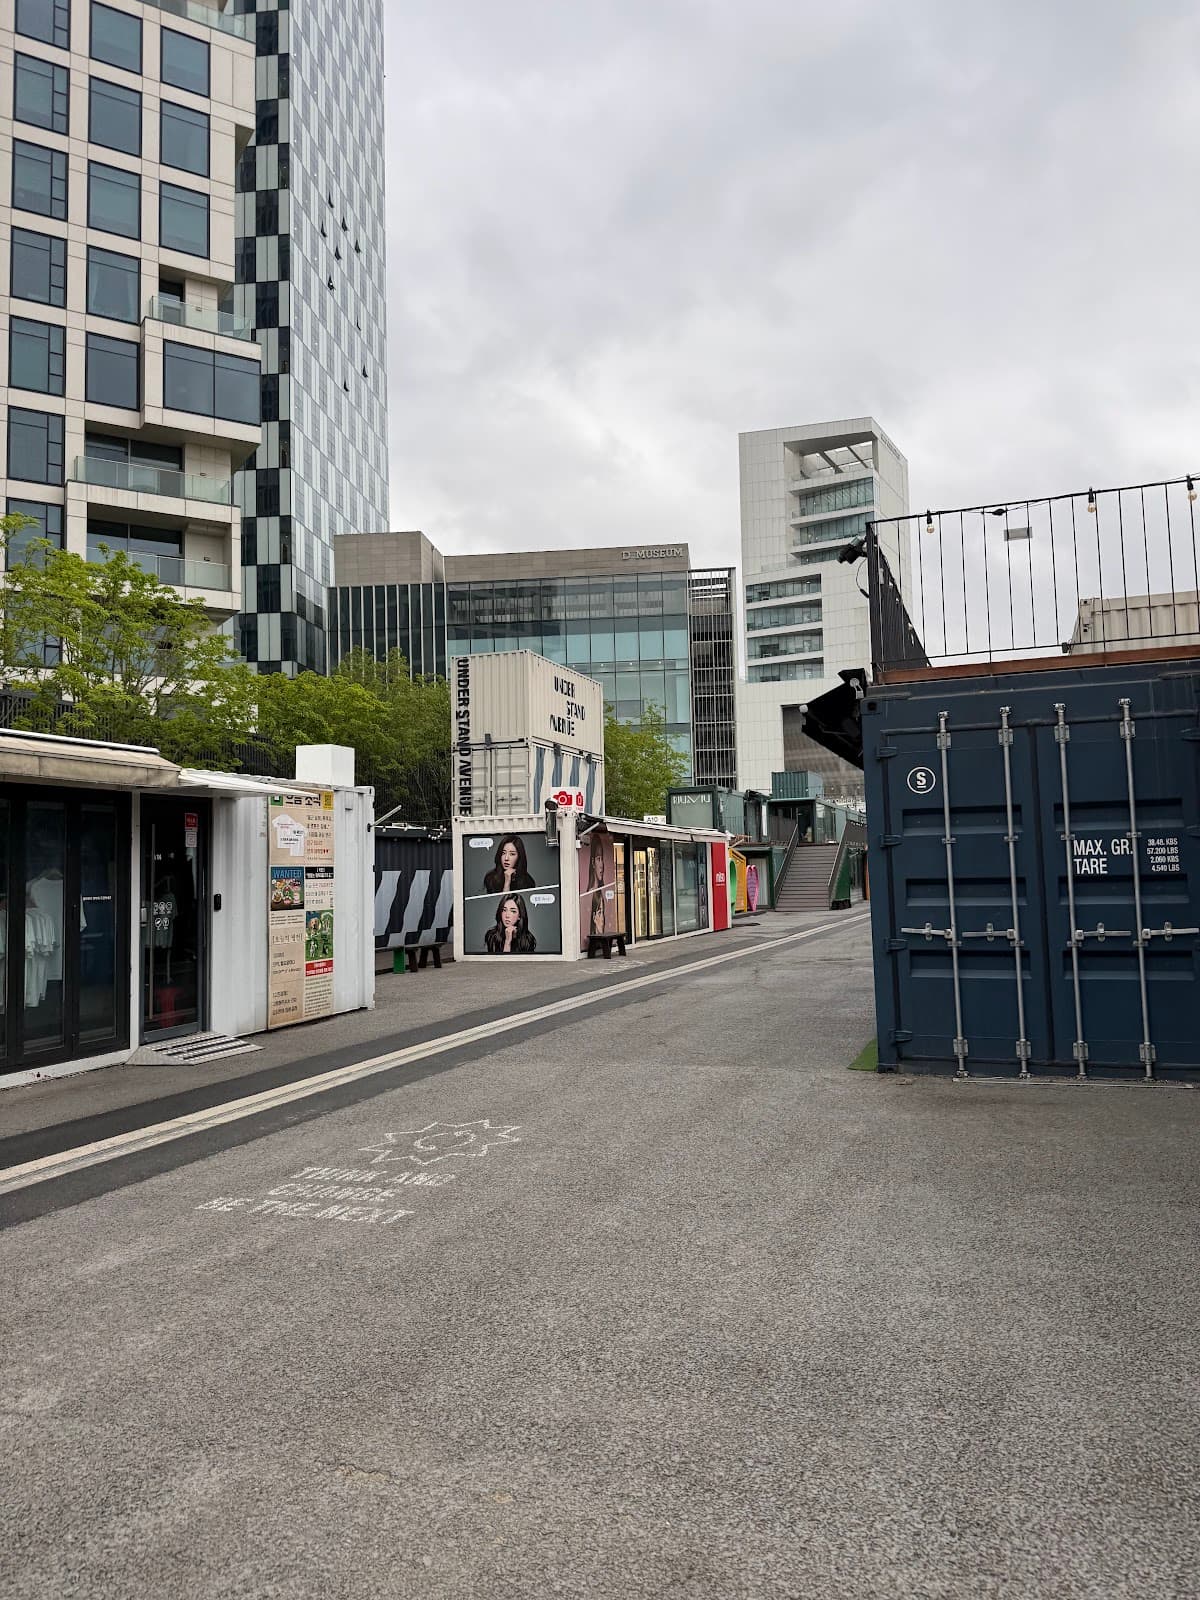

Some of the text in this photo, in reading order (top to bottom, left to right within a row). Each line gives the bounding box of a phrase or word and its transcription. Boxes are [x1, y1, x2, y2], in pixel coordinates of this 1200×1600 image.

[622, 548, 684, 560] D MUSEUM
[554, 676, 575, 698] UNDER
[566, 700, 585, 720] STAND
[550, 714, 575, 736] AVENUE
[456, 657, 472, 816] UNDER STAND AVENUE
[1073, 839, 1133, 856] MAX. GR.
[273, 869, 302, 878] WANTED
[1073, 858, 1108, 875] TARE
[1168, 864, 1180, 872] LBS
[291, 1166, 456, 1186] THINK AND
[247, 1200, 322, 1216] THE
[314, 1204, 415, 1224] NEXT
